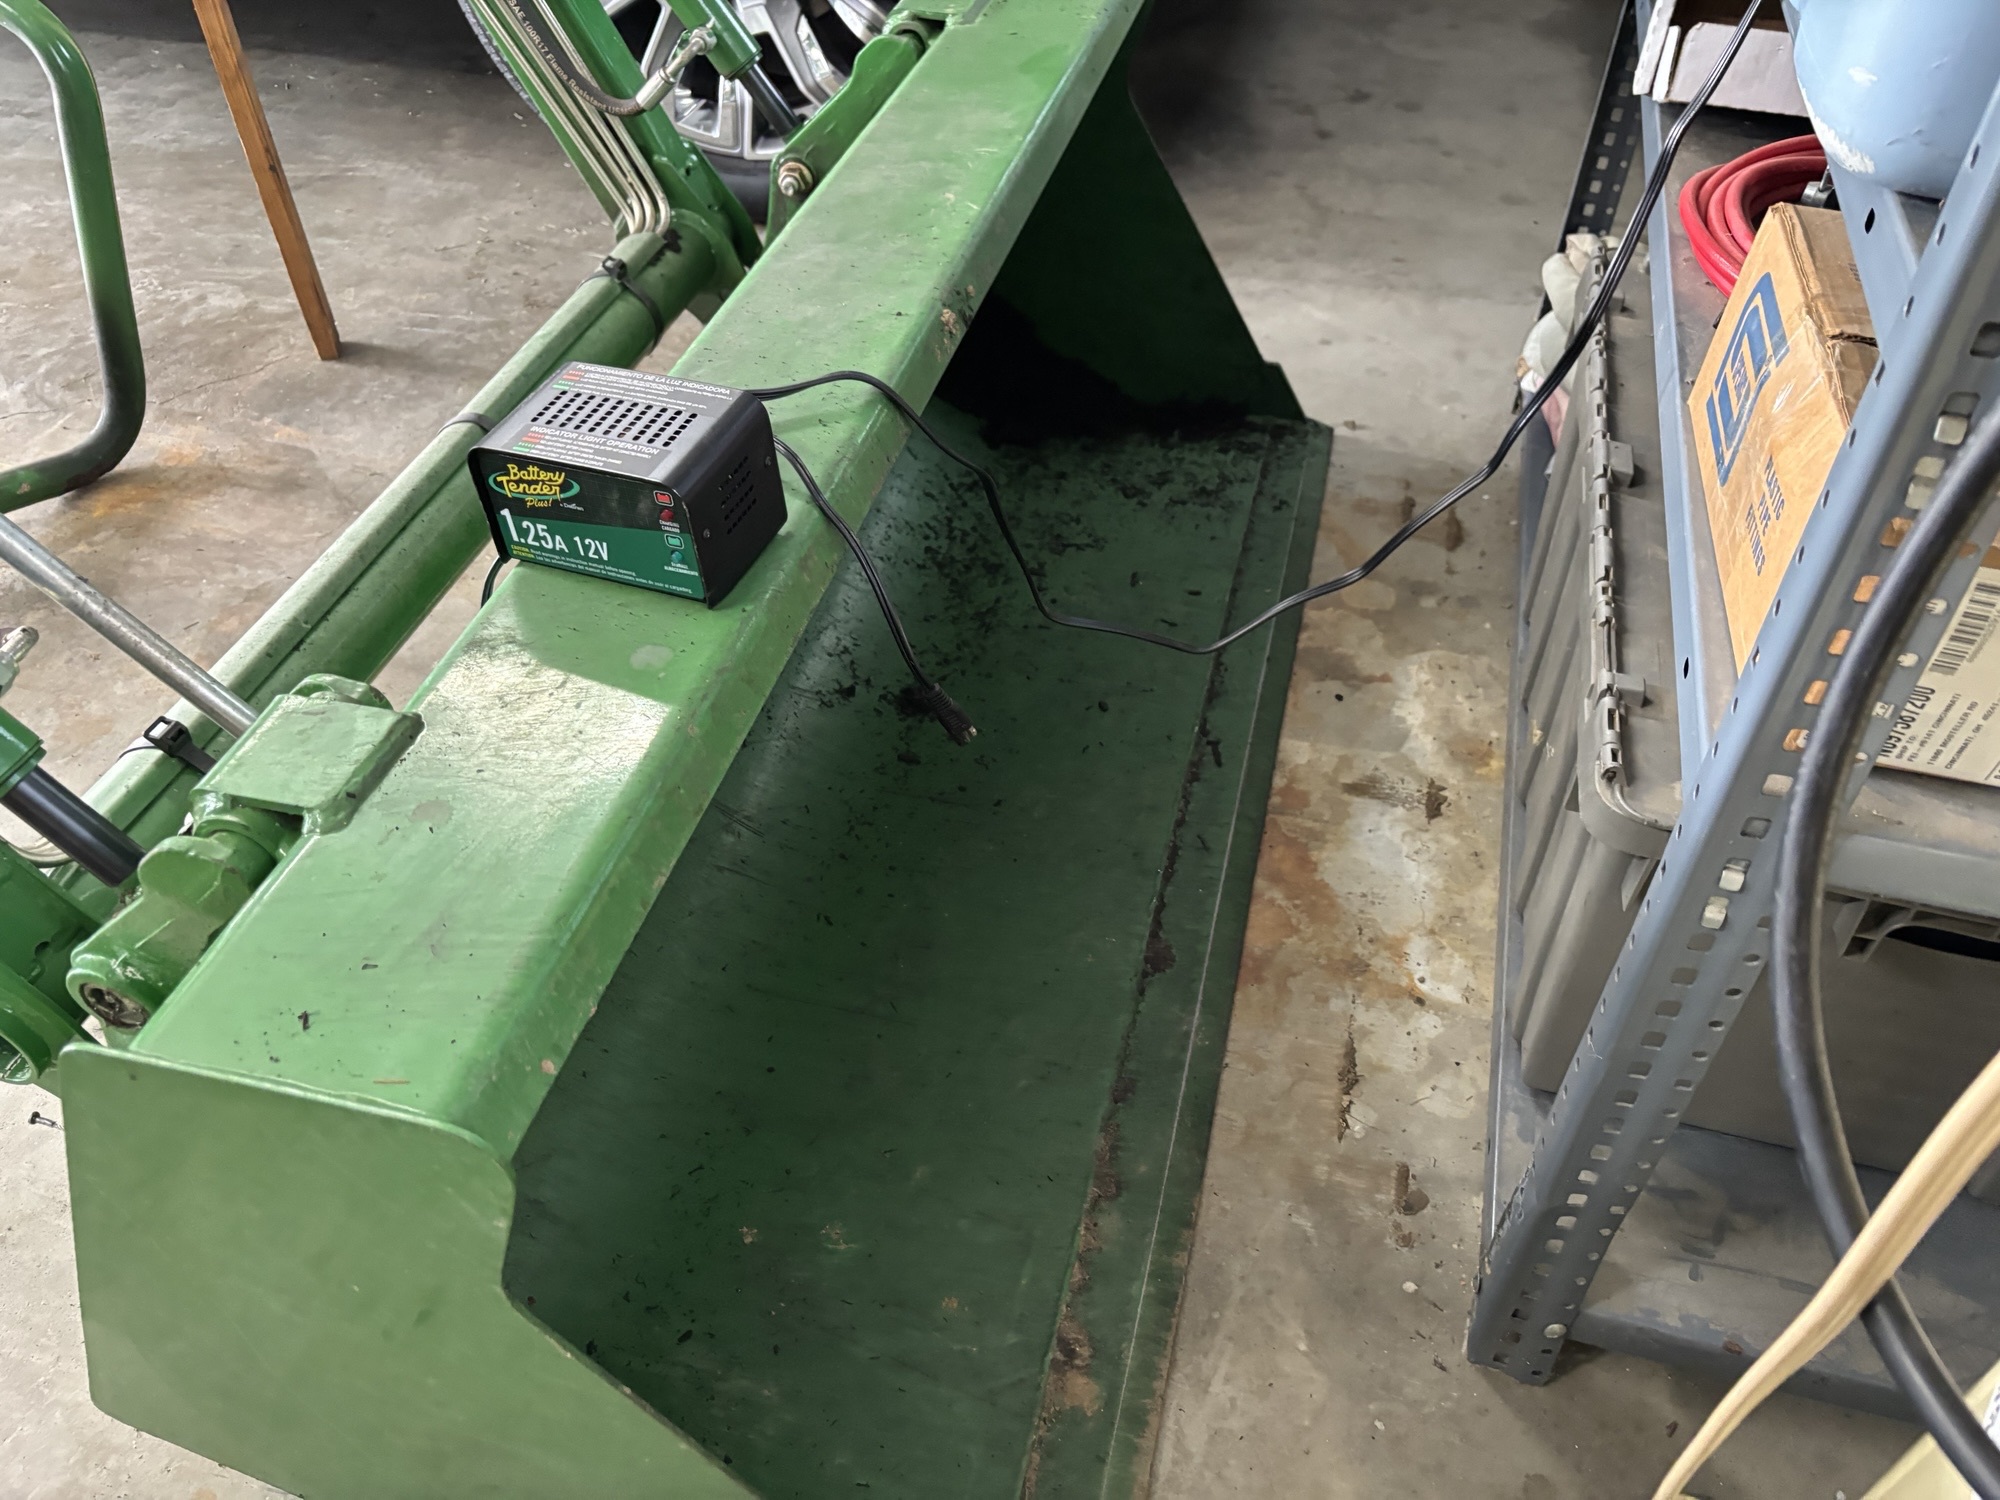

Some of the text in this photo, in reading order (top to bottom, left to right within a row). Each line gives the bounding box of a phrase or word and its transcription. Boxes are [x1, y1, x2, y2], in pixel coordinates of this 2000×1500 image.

[508, 0, 526, 19] SAE
[524, 20, 549, 53] 100R17
[546, 53, 568, 80] Flame
[568, 79, 607, 110] Resistant
[576, 363, 643, 379] FUNCIONAMIENTO
[682, 381, 730, 395] INDICADORA
[530, 426, 579, 439] INDICATOR
[579, 432, 606, 444] LIGHT
[606, 439, 660, 455] OPERATION
[496, 476, 562, 501] Tender
[506, 463, 565, 485] Battery
[1764, 454, 1785, 521] PLASTIC
[525, 497, 553, 508] Plus!
[1757, 492, 1771, 537] PIPE
[500, 508, 608, 561] 1.25A 12V
[1745, 503, 1766, 577] FITTINGS
[1931, 693, 1962, 730] CINCINNATI
